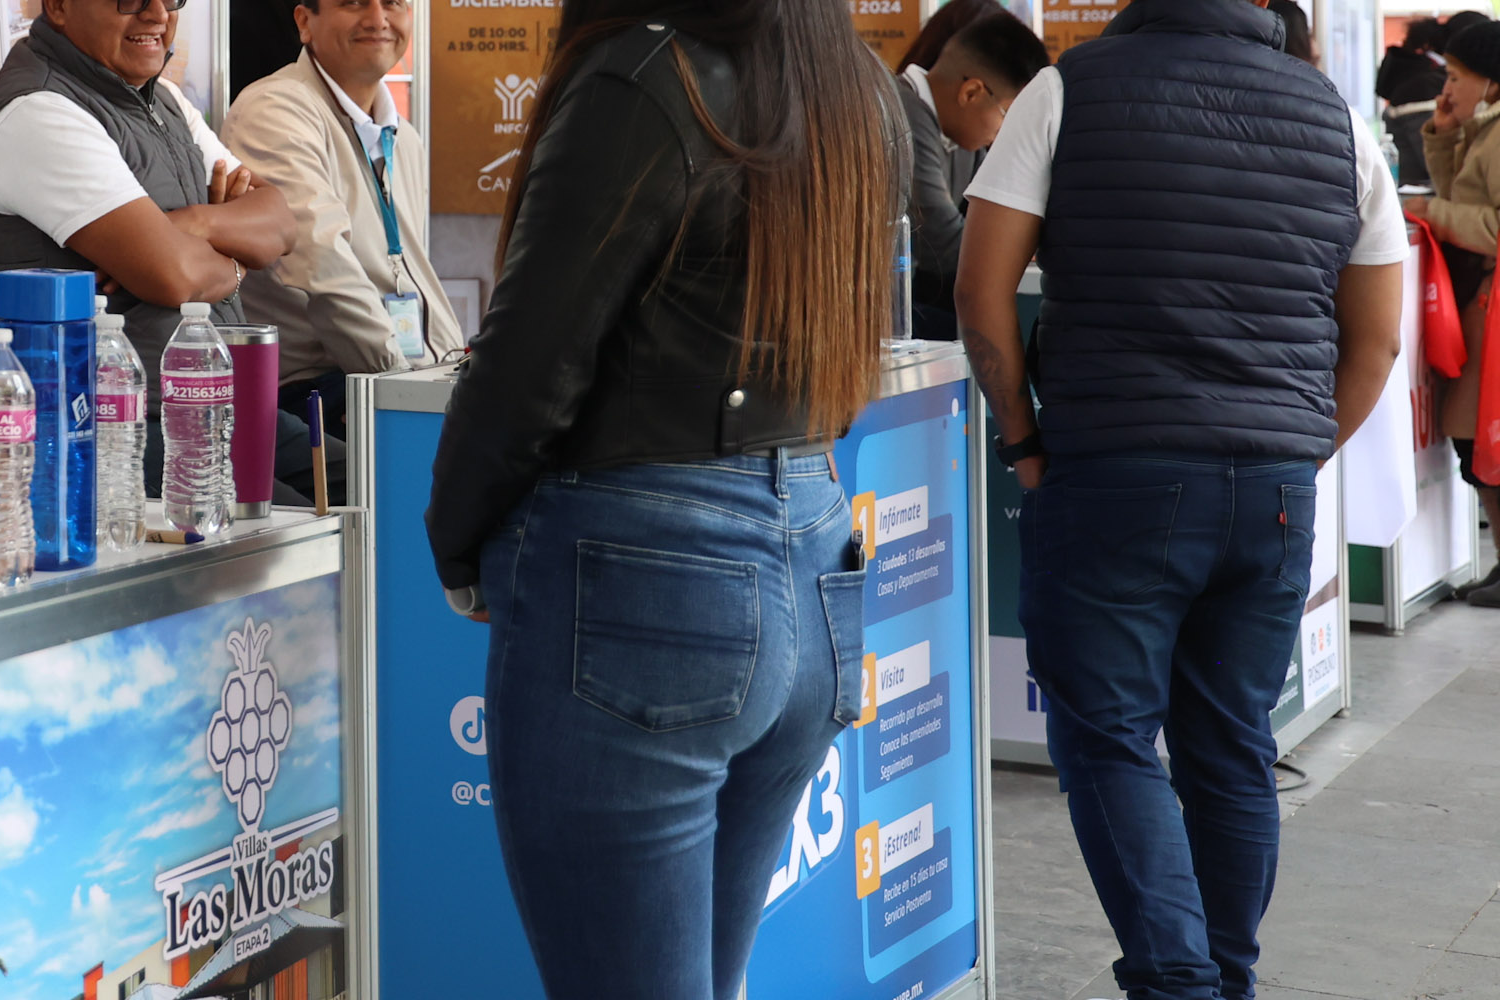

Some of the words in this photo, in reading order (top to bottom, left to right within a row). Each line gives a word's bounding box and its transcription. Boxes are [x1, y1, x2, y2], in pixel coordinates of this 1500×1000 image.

[859, 0, 902, 14] 2024
[469, 27, 486, 38] DE
[490, 27, 527, 38] 10:00
[447, 42, 456, 51] A
[460, 42, 495, 51] 19:00
[499, 42, 529, 52] HRS.
[0, 414, 16, 425] AL
[879, 502, 922, 534] Infórmate
[876, 559, 882, 574] 3
[882, 552, 907, 572] ciudades
[908, 548, 915, 563] 13
[877, 582, 894, 597] Casas
[898, 565, 939, 591] Departamentos
[881, 666, 905, 691] Visita
[880, 738, 900, 757] Conoce
[900, 732, 909, 748] las
[880, 754, 914, 781] Seguimiento
[235, 834, 268, 861] Villas
[862, 837, 873, 880] 3
[884, 820, 922, 864] ¡Estrena!
[884, 880, 901, 904] Recibe
[902, 879, 910, 892] en
[910, 872, 917, 889] 15
[917, 866, 929, 885] días
[929, 864, 936, 877] tu
[166, 890, 225, 953] Las
[233, 846, 332, 925] Moras
[884, 902, 906, 928] Servicio
[905, 889, 932, 916] Postventa
[236, 934, 262, 957] ETAPA
[263, 927, 269, 945] 2
